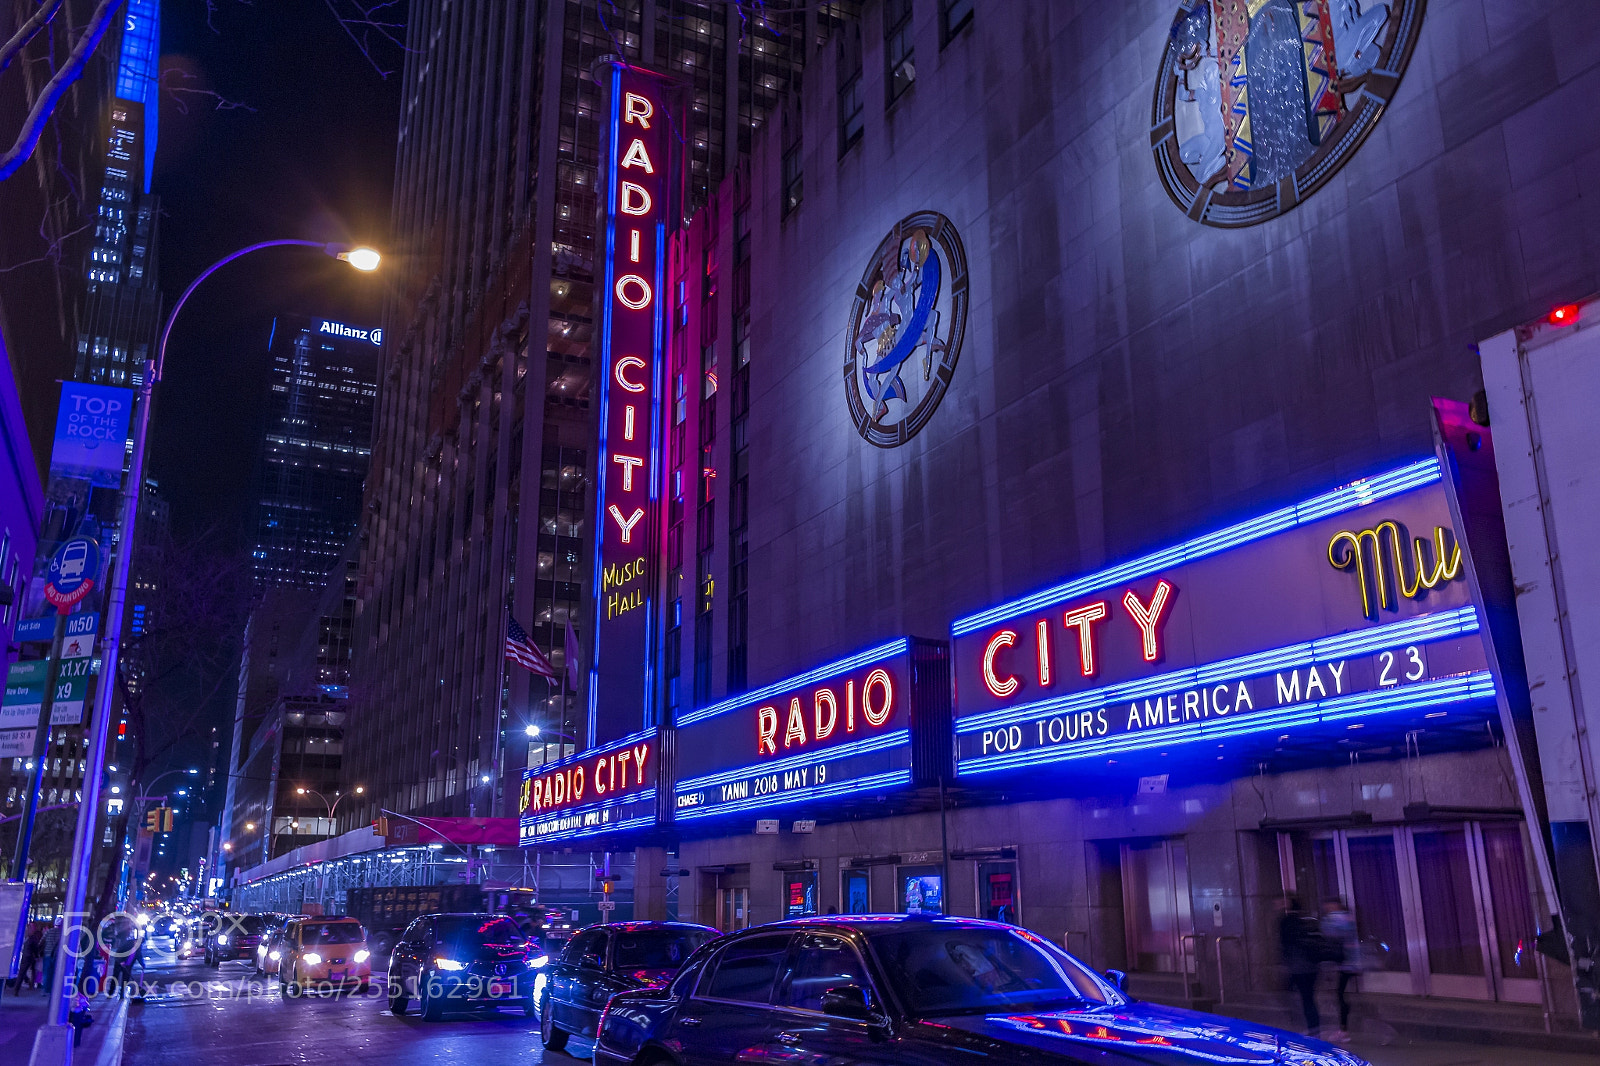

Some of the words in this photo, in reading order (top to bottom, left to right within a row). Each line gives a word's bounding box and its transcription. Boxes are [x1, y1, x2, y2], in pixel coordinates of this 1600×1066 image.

[615, 91, 654, 310] RADIO
[320, 321, 368, 340] Allianz
[70, 394, 122, 416] TOP
[68, 413, 88, 423] OF
[92, 415, 119, 428] THE
[66, 423, 117, 441] ROCK
[608, 355, 646, 544] CITY
[46, 585, 56, 598] NO
[54, 582, 89, 603] STANDING
[18, 622, 29, 632] East
[68, 615, 94, 634] M50
[982, 577, 1174, 699] CITY
[982, 725, 1022, 755] POD
[1036, 707, 1109, 746] TOURS
[1126, 680, 1254, 731] AMERICA
[1275, 659, 1346, 705] MAY
[1378, 645, 1425, 687] 23
[758, 668, 892, 755] RADIO
[533, 765, 585, 811] RADIO
[594, 743, 648, 794] CITY
[721, 781, 749, 803] YANNI
[754, 774, 778, 795] 2018
[784, 767, 808, 789] MAY
[814, 764, 826, 785] 19
[677, 792, 699, 808] CHASE
